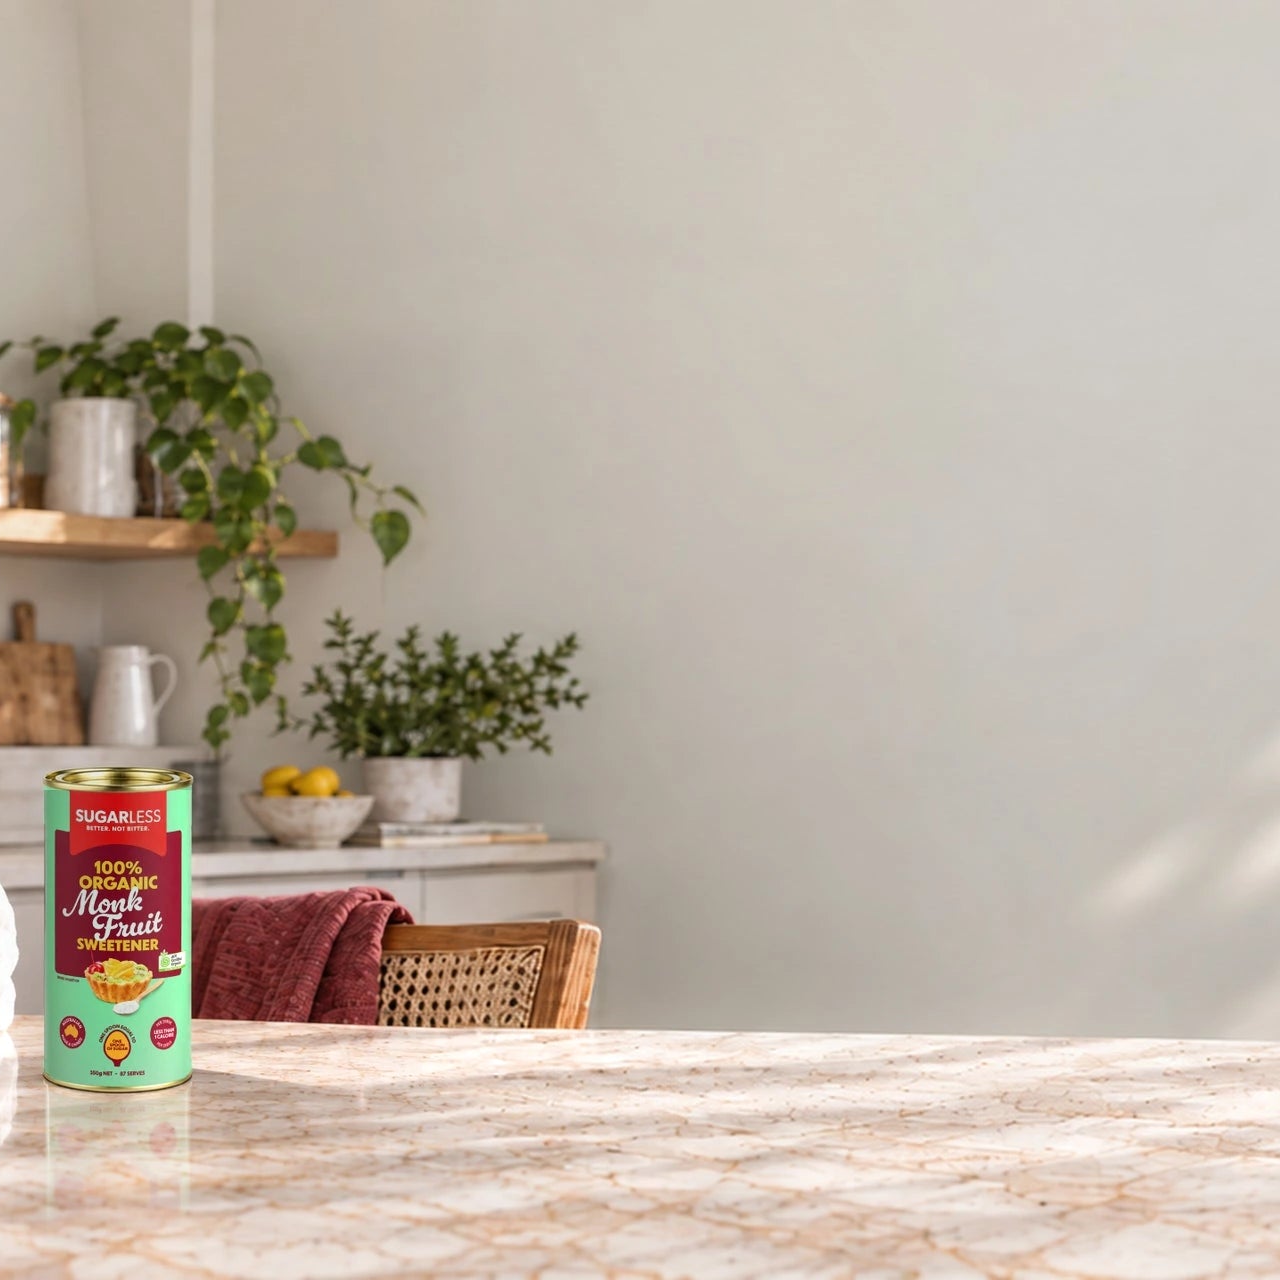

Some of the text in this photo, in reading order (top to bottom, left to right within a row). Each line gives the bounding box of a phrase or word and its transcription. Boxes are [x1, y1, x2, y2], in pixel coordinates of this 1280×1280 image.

[75, 808, 161, 824] SUGARLESS
[94, 860, 143, 875] 100%
[79, 875, 158, 891] ORGANIC
[62, 886, 143, 917] Monk
[92, 910, 163, 941] Fruit
[76, 938, 159, 952] SWEETENER
[104, 1024, 121, 1033] SPOON
